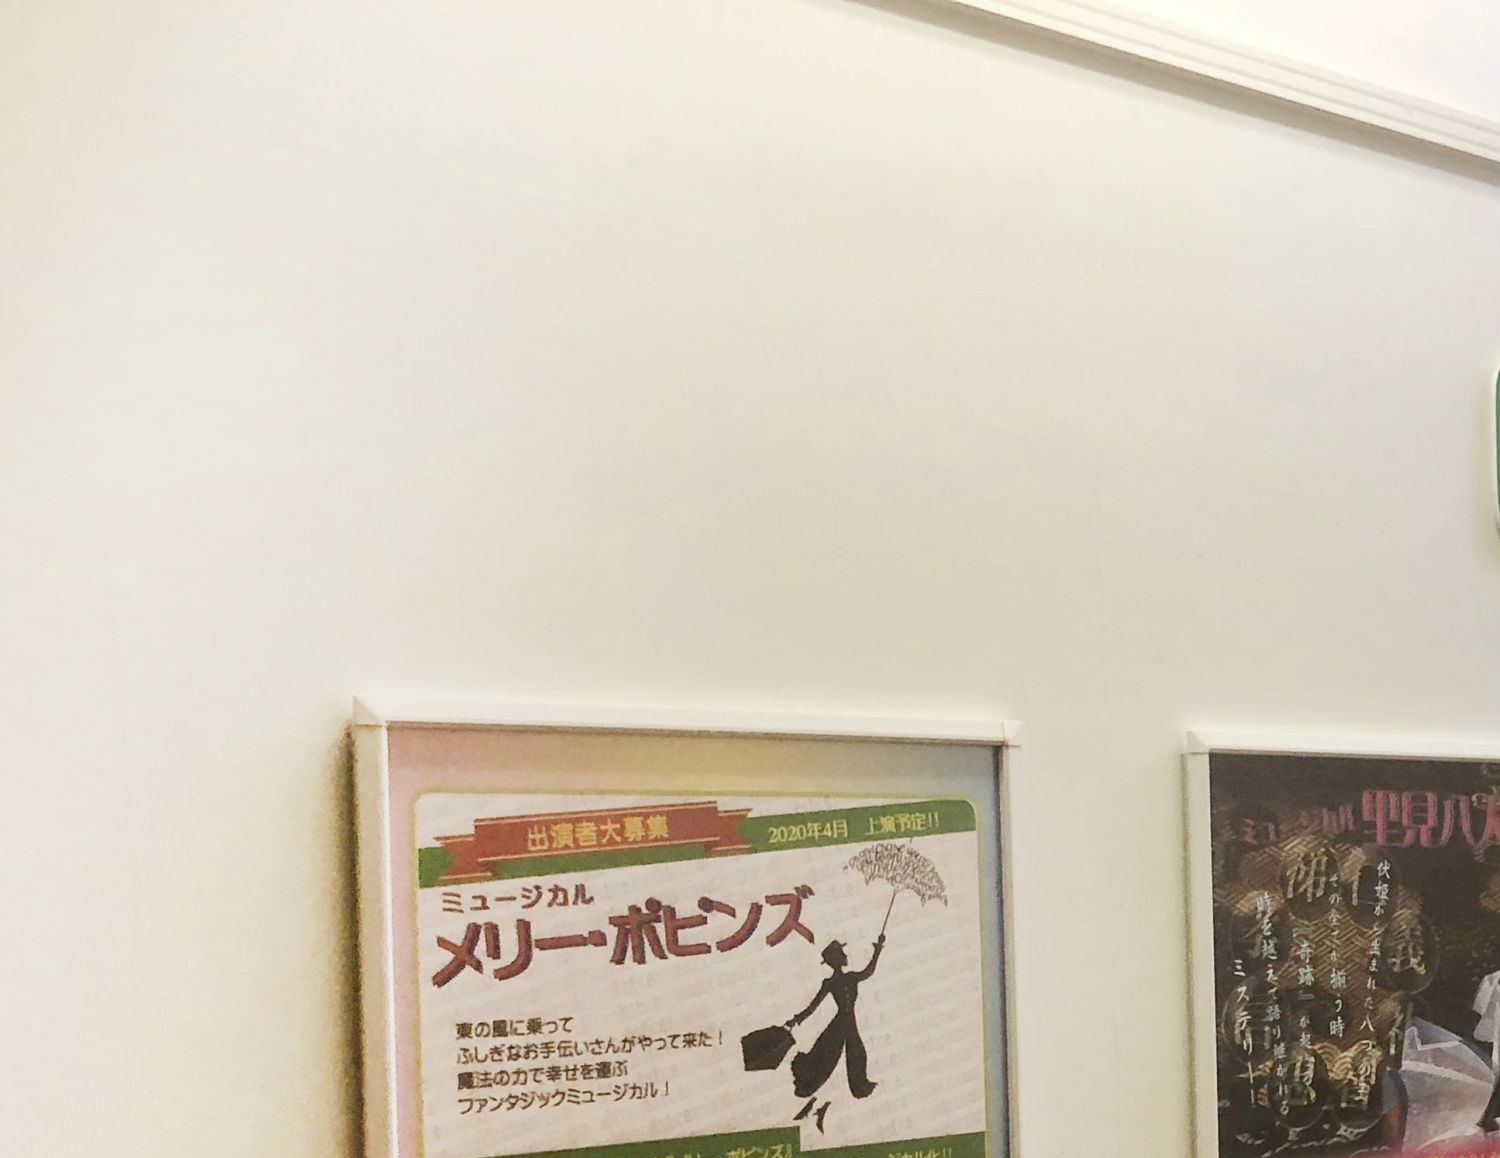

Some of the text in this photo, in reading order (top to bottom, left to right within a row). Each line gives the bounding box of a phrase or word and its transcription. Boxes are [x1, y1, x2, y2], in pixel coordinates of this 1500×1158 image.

[526, 816, 668, 852] 出演者大募集
[768, 818, 849, 844] 2020年4月
[440, 883, 594, 915] ミュージカル
[432, 884, 815, 988] メリー・ポピンズ
[455, 1016, 573, 1041] 東の風に乗って
[457, 1061, 628, 1091] 魔法の力で幸せを運ぶ
